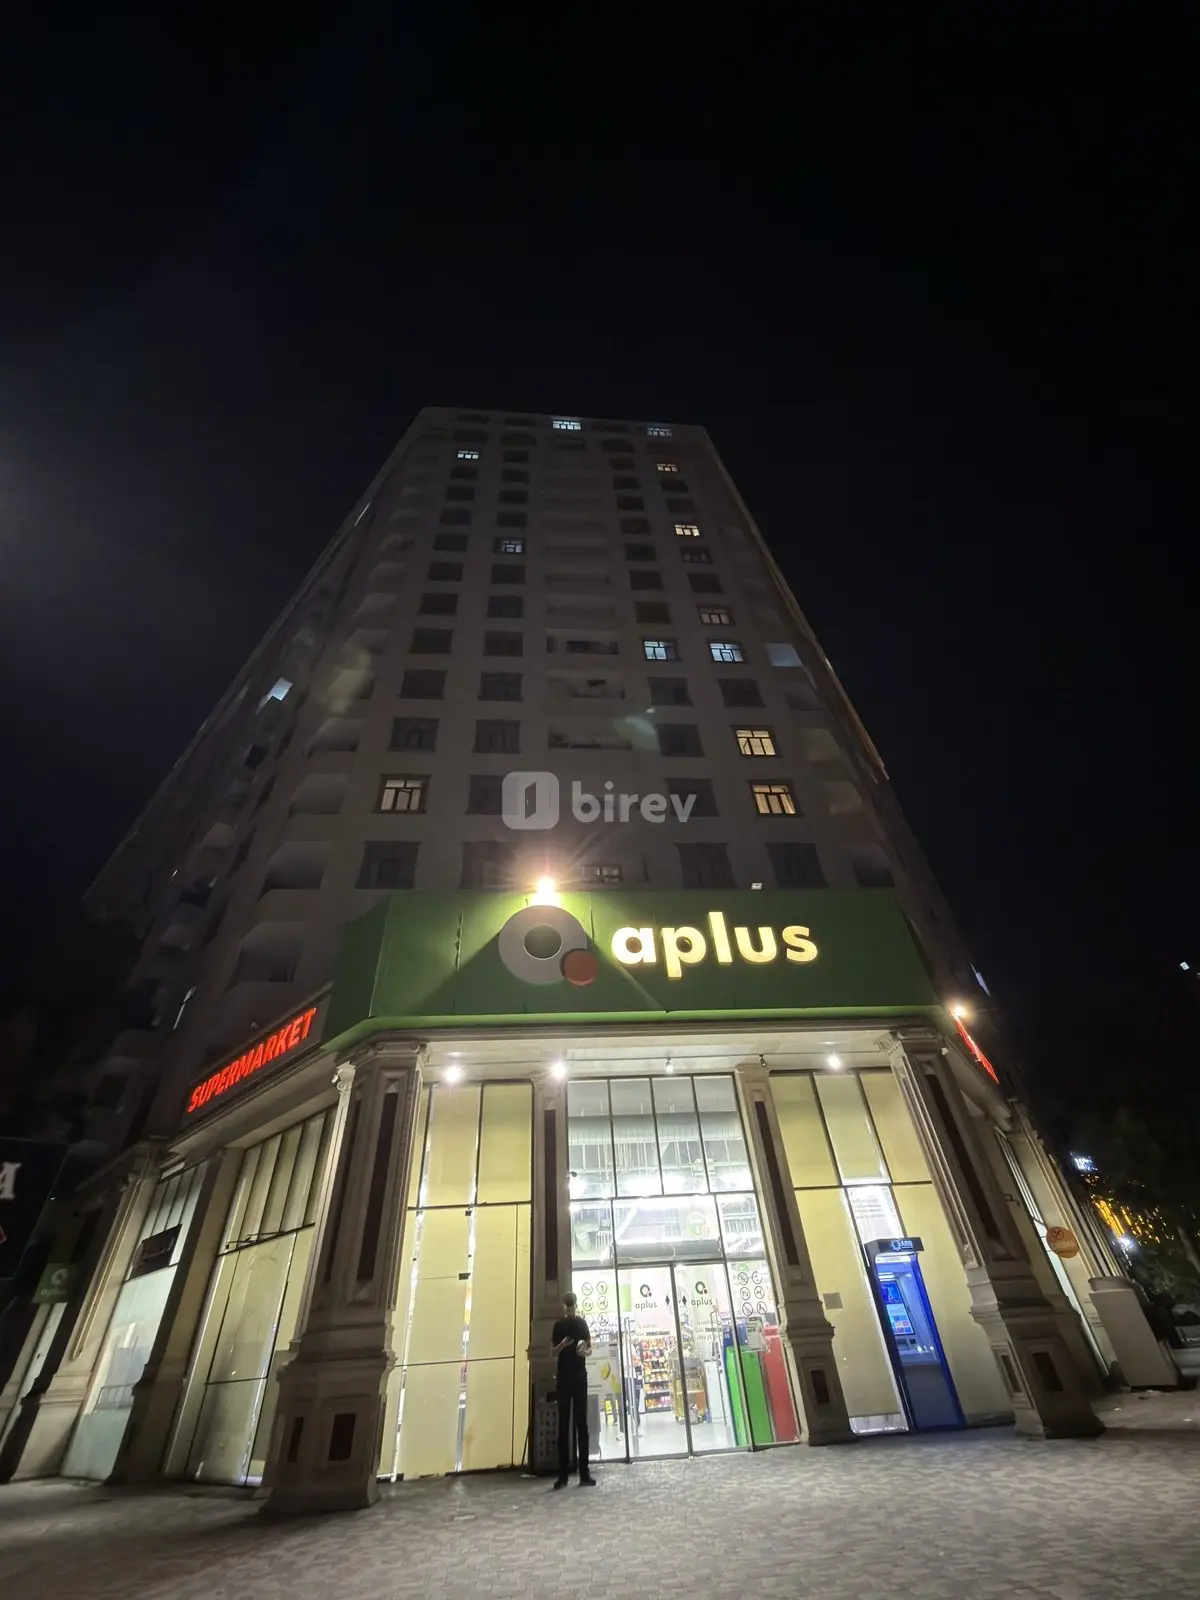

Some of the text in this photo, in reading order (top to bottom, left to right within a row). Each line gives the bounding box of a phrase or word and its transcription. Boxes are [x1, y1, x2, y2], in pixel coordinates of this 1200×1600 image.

[611, 911, 818, 980] aplus
[187, 1007, 317, 1113] SUPERMARKET
[635, 1300, 658, 1311] aplus
[691, 1296, 713, 1307] aplus
